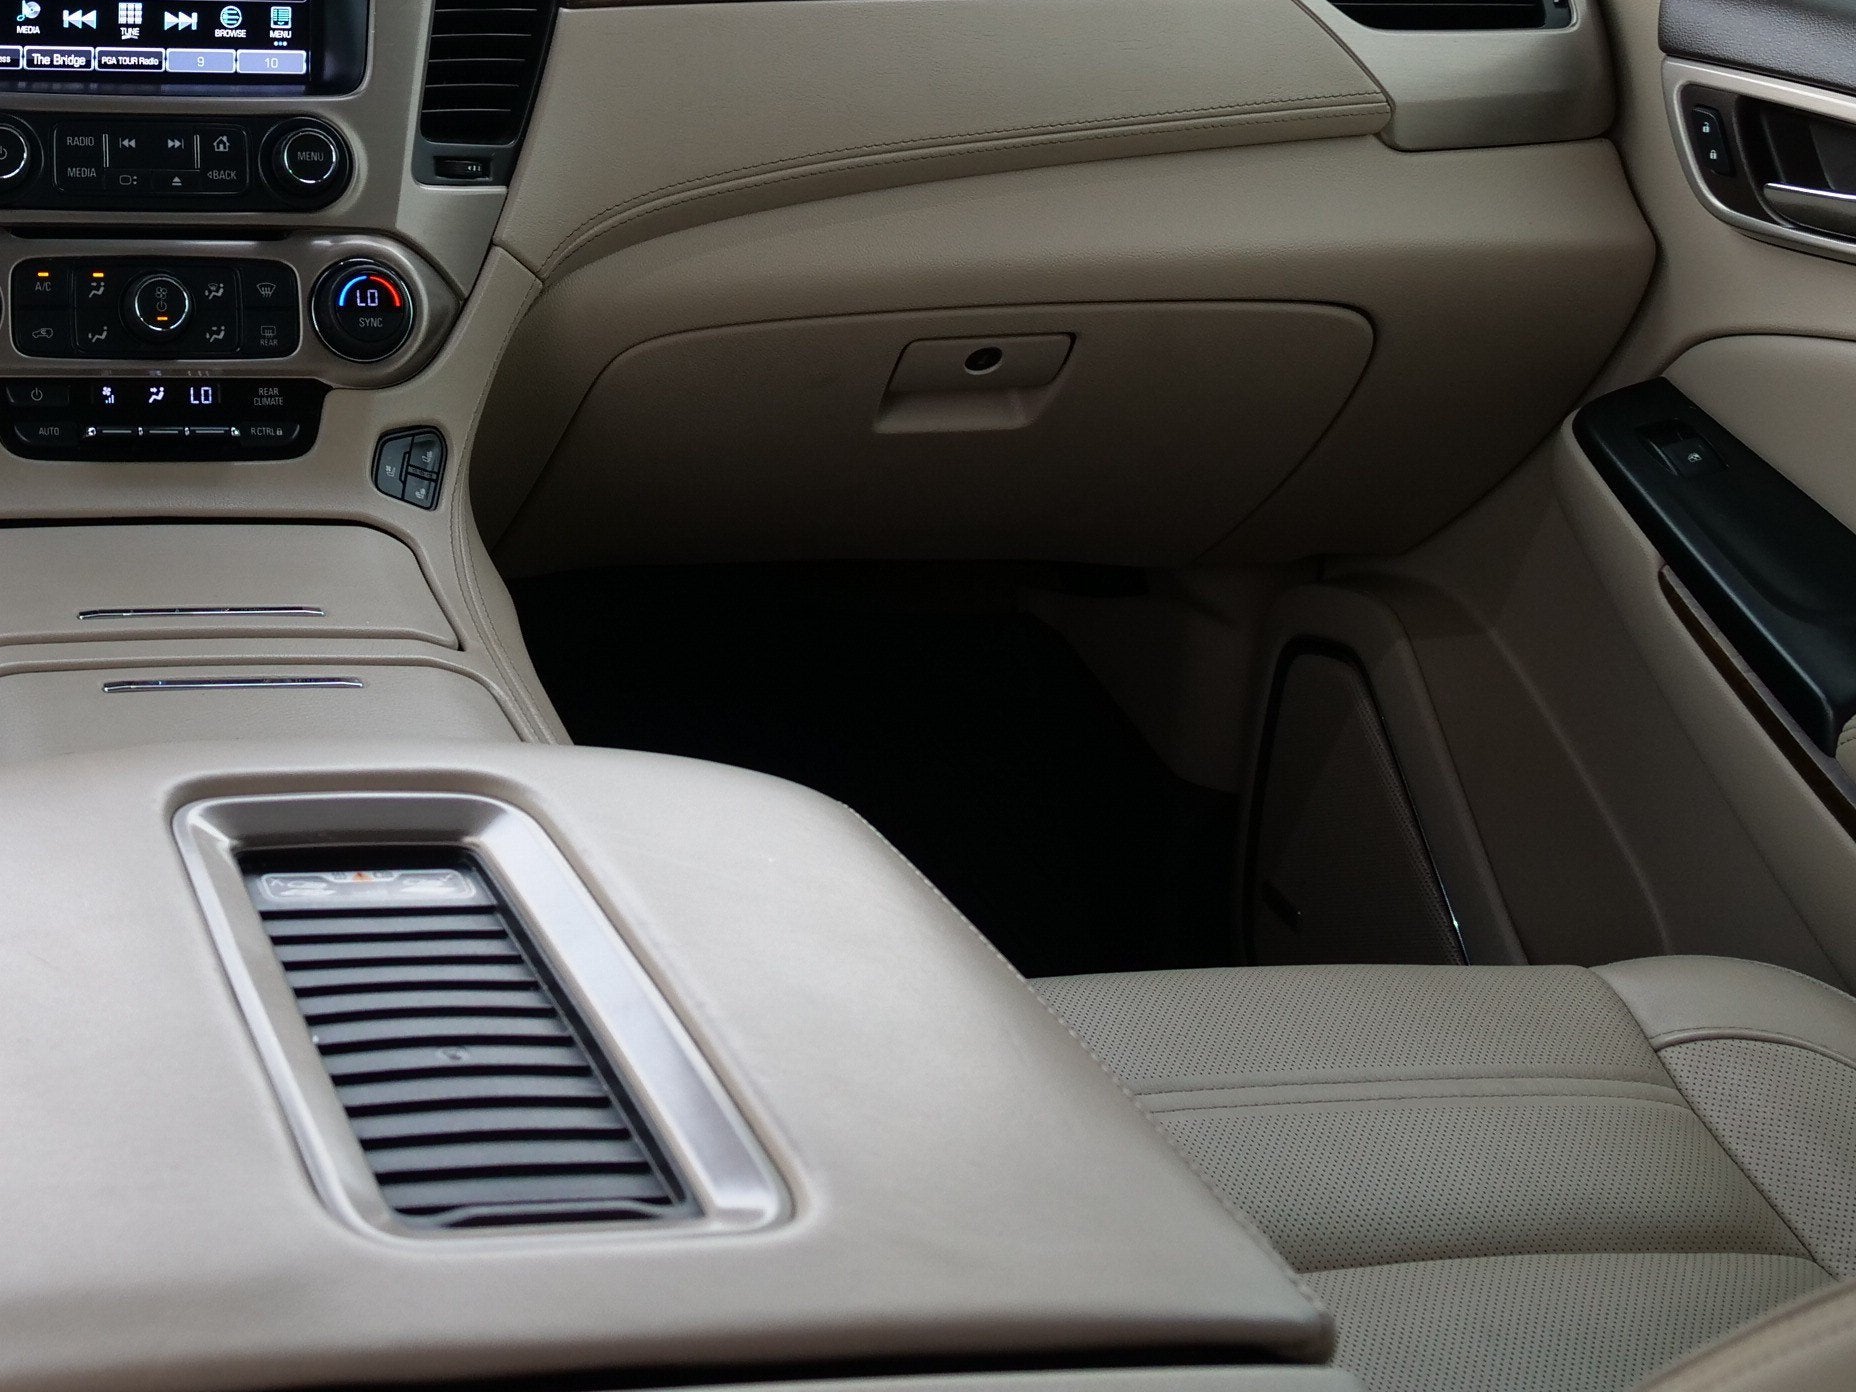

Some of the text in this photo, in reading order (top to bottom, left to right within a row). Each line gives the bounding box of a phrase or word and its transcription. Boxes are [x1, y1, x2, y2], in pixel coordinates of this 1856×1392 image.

[16, 26, 40, 34] MEDIA
[120, 28, 140, 36] TUNE
[214, 30, 246, 38] BROWSE
[270, 30, 292, 38] MENU
[31, 53, 86, 68] The Bridge
[101, 56, 160, 66] PGA TOUR Radio
[197, 56, 205, 67] 9
[264, 58, 278, 68] 10
[66, 136, 94, 147] RADIO
[296, 151, 324, 162] MENU
[67, 168, 96, 178] MEDIA
[212, 170, 236, 180] BACK
[34, 282, 51, 292] A/C
[356, 289, 378, 306] LO
[358, 318, 383, 328] SYNC
[190, 386, 212, 404] LO
[258, 388, 279, 396] REAR
[253, 397, 284, 406] CLIMATE
[38, 427, 60, 436] AUTO
